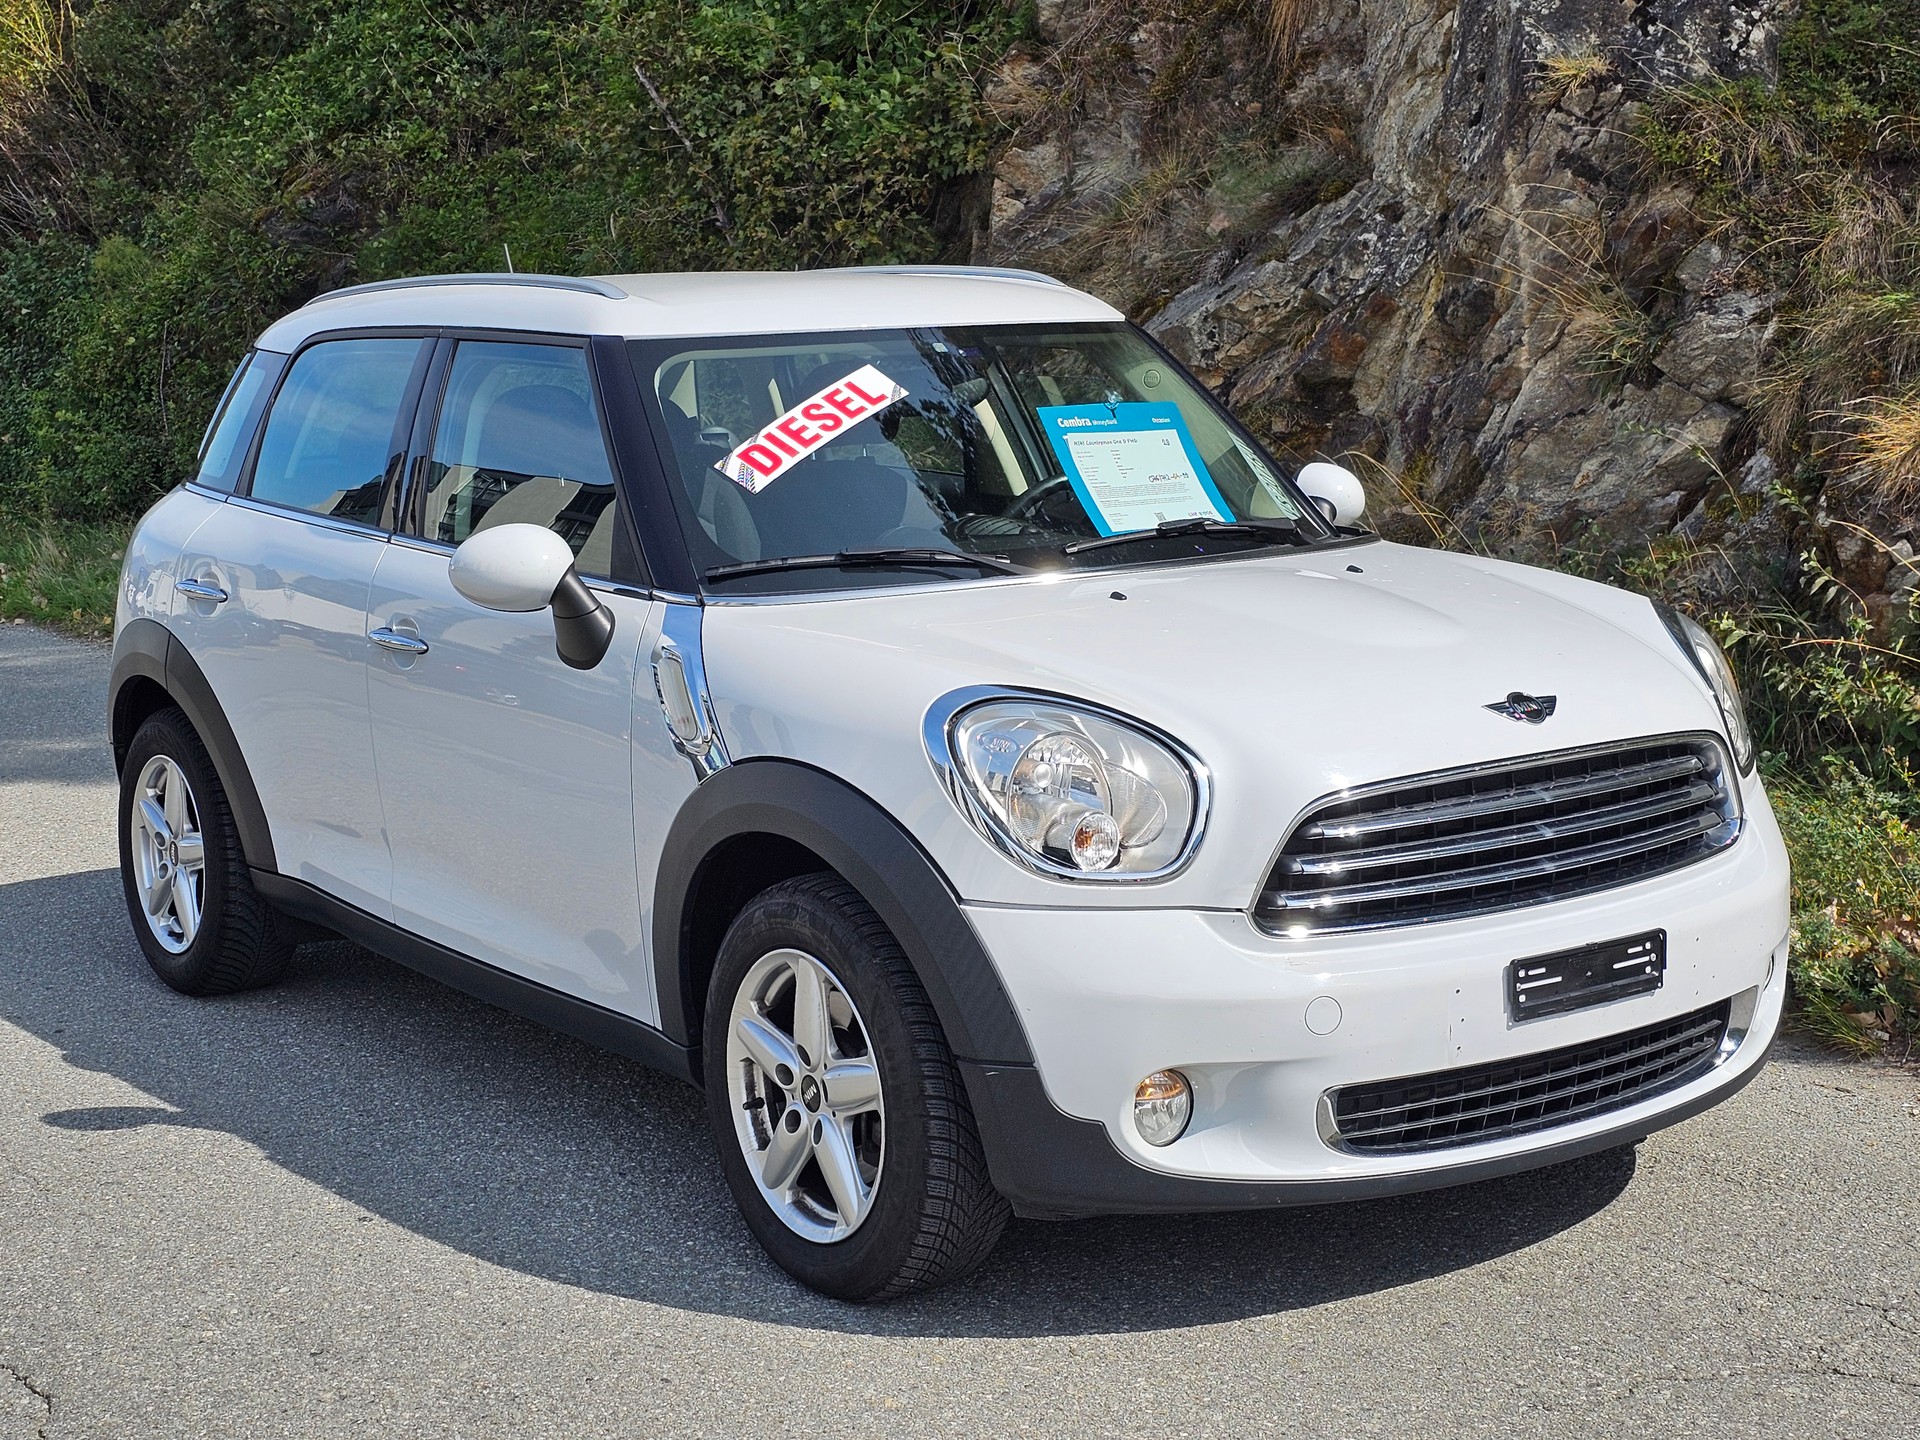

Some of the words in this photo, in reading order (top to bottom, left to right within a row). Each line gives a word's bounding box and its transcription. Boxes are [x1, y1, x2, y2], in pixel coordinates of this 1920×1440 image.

[1057, 416, 1092, 428] Cembra
[737, 381, 889, 477] DIESEL
[1514, 701, 1541, 714] MINI
[991, 737, 1010, 749] MINI
